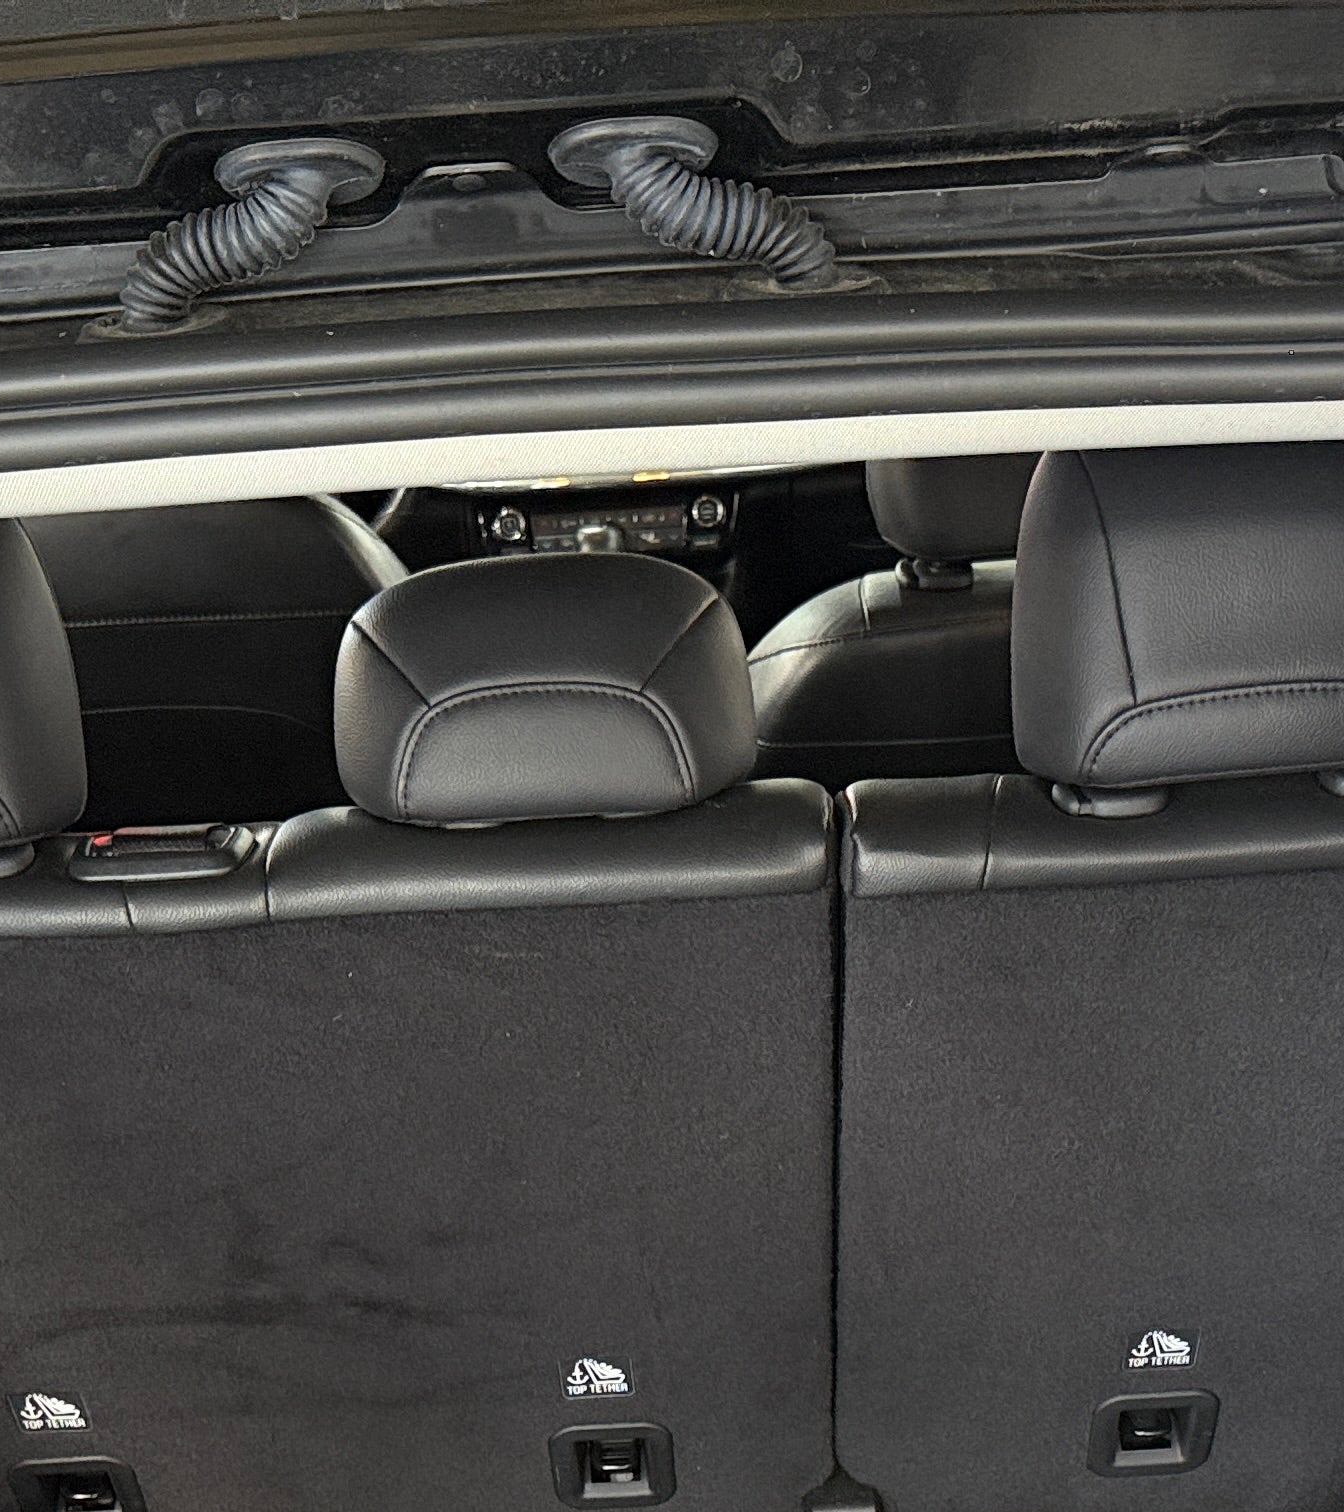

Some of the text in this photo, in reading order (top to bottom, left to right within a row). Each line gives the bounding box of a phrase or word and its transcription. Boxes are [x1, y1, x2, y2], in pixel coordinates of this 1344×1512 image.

[1128, 1355, 1190, 1368] TOP TETHER
[567, 1382, 628, 1396] TOP TETHER
[22, 1418, 86, 1430] TOP TETHER
